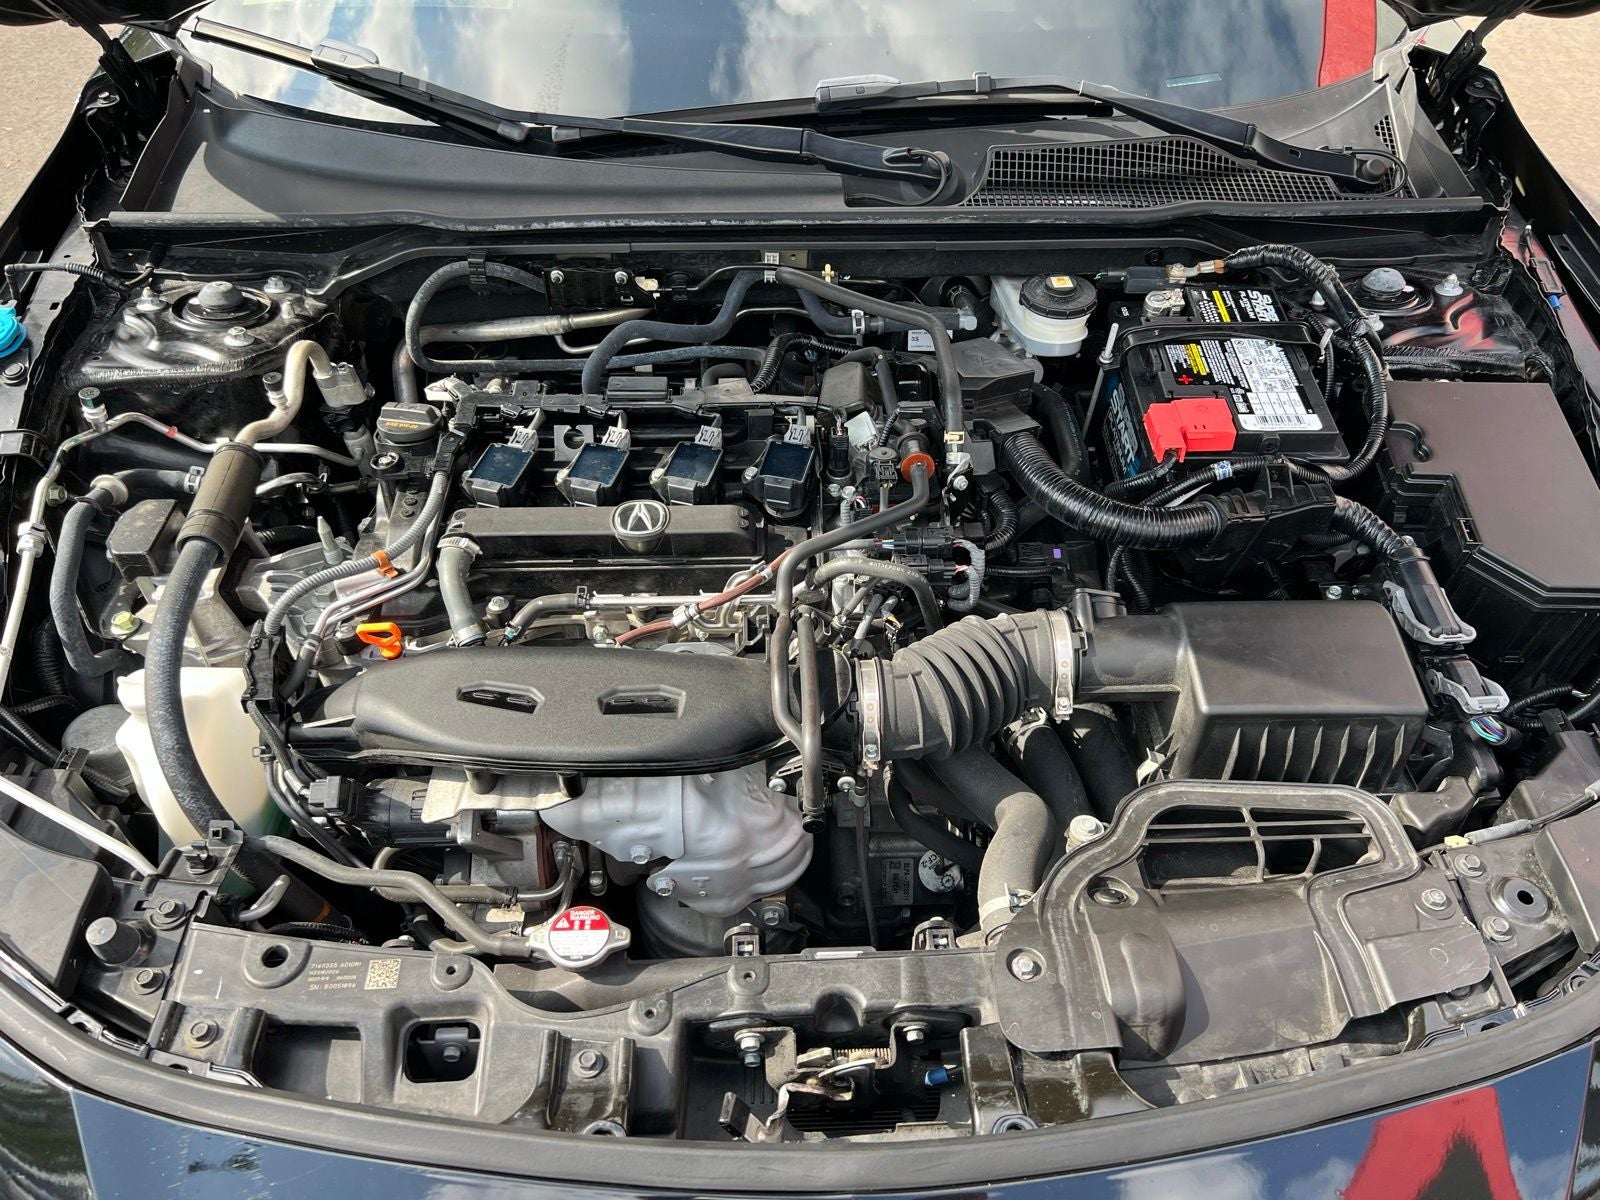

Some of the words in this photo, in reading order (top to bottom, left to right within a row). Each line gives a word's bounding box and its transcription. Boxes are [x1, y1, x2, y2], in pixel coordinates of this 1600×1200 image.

[1238, 290, 1257, 320] PLATINUM
[1107, 412, 1128, 475] PLATINUM
[1110, 388, 1136, 465] START
[1117, 382, 1139, 456] SUPER
